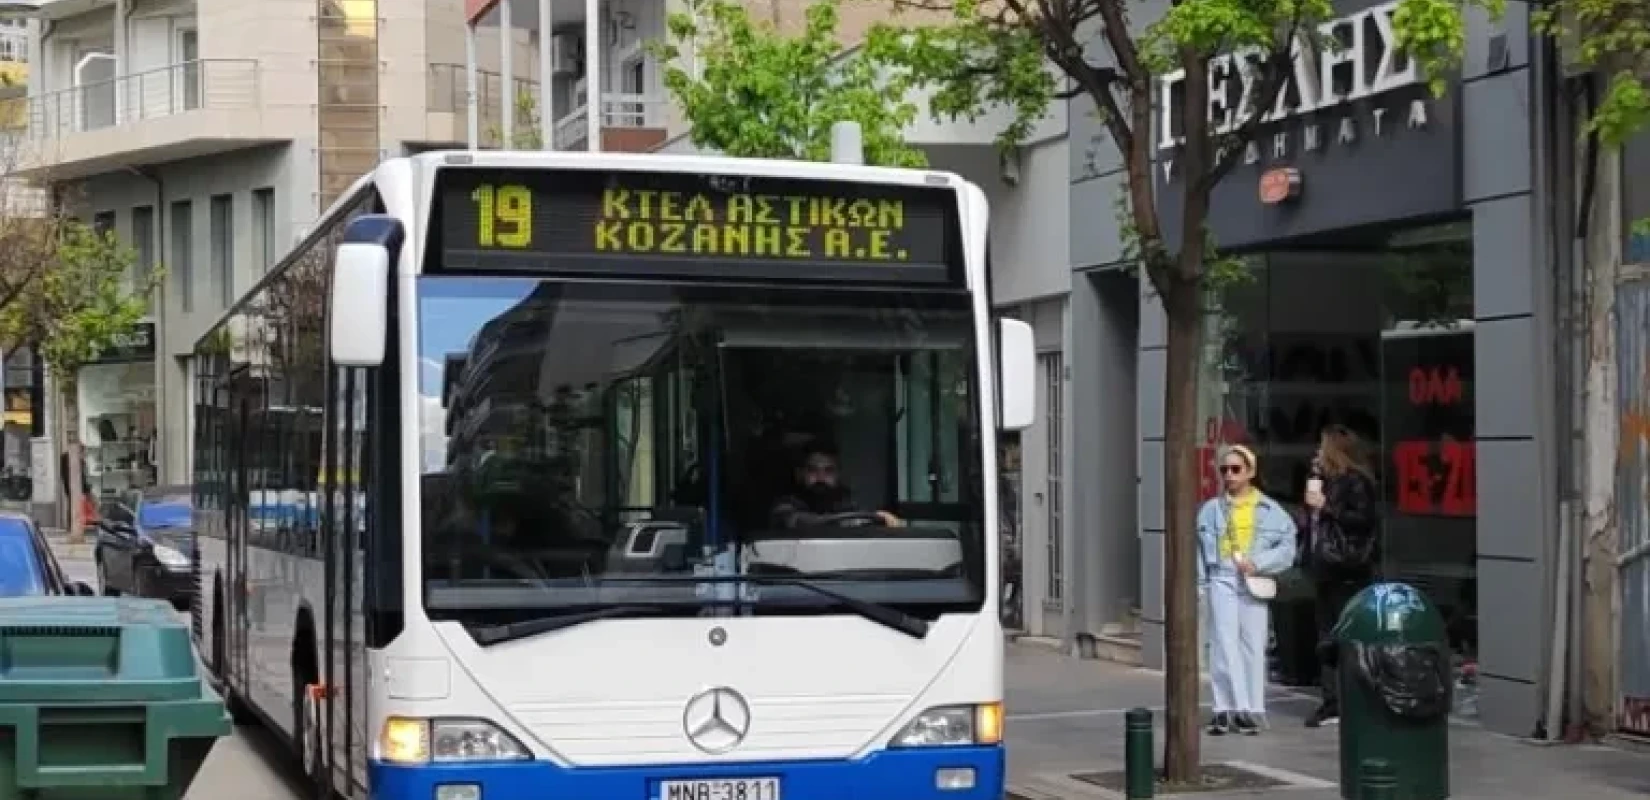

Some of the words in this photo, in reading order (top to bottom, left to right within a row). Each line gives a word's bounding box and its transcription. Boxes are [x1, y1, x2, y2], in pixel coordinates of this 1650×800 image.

[1163, 99, 1428, 185] ΥΔΗΜΑΤΑ
[471, 184, 532, 247] 19
[602, 188, 714, 221] ΚΤΕΛ
[727, 193, 904, 228] ΑΣΤΙΚΩΝ
[594, 219, 811, 258] ΚΟΖΑΝΗΣ
[824, 229, 909, 260] Α.Ε.
